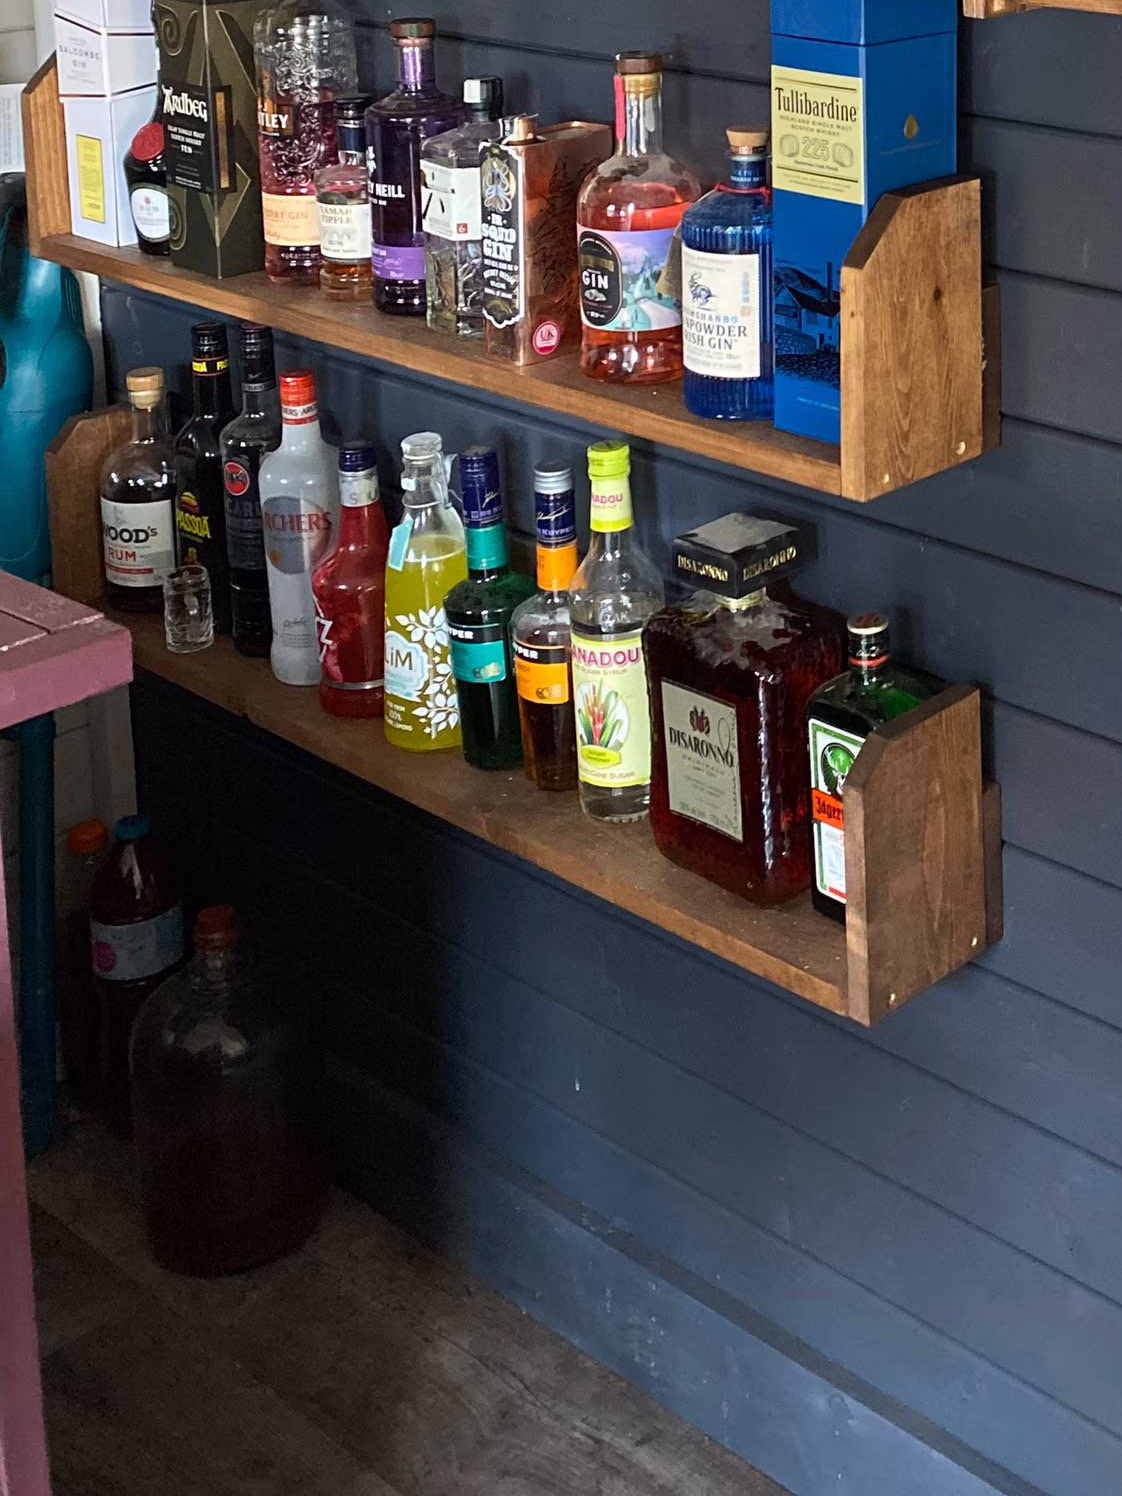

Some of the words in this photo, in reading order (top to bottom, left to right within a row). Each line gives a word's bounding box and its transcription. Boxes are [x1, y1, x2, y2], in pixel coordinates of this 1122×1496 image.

[775, 86, 858, 123] Tullibardine
[780, 115, 811, 126] HIGHLAND
[811, 120, 834, 130] SINGLE
[836, 123, 852, 132] MALT
[791, 124, 815, 134] SCOTCH
[816, 128, 840, 138] WHISKY
[801, 135, 830, 162] 225
[375, 184, 405, 198] NEILL
[482, 239, 513, 262] GIN
[582, 270, 609, 290] GIN
[708, 337, 738, 351] GIN
[108, 547, 136, 562] RUM
[743, 546, 797, 581] DISARONNO
[677, 554, 729, 581] DISARONNO
[669, 726, 735, 768] DISARONNO
